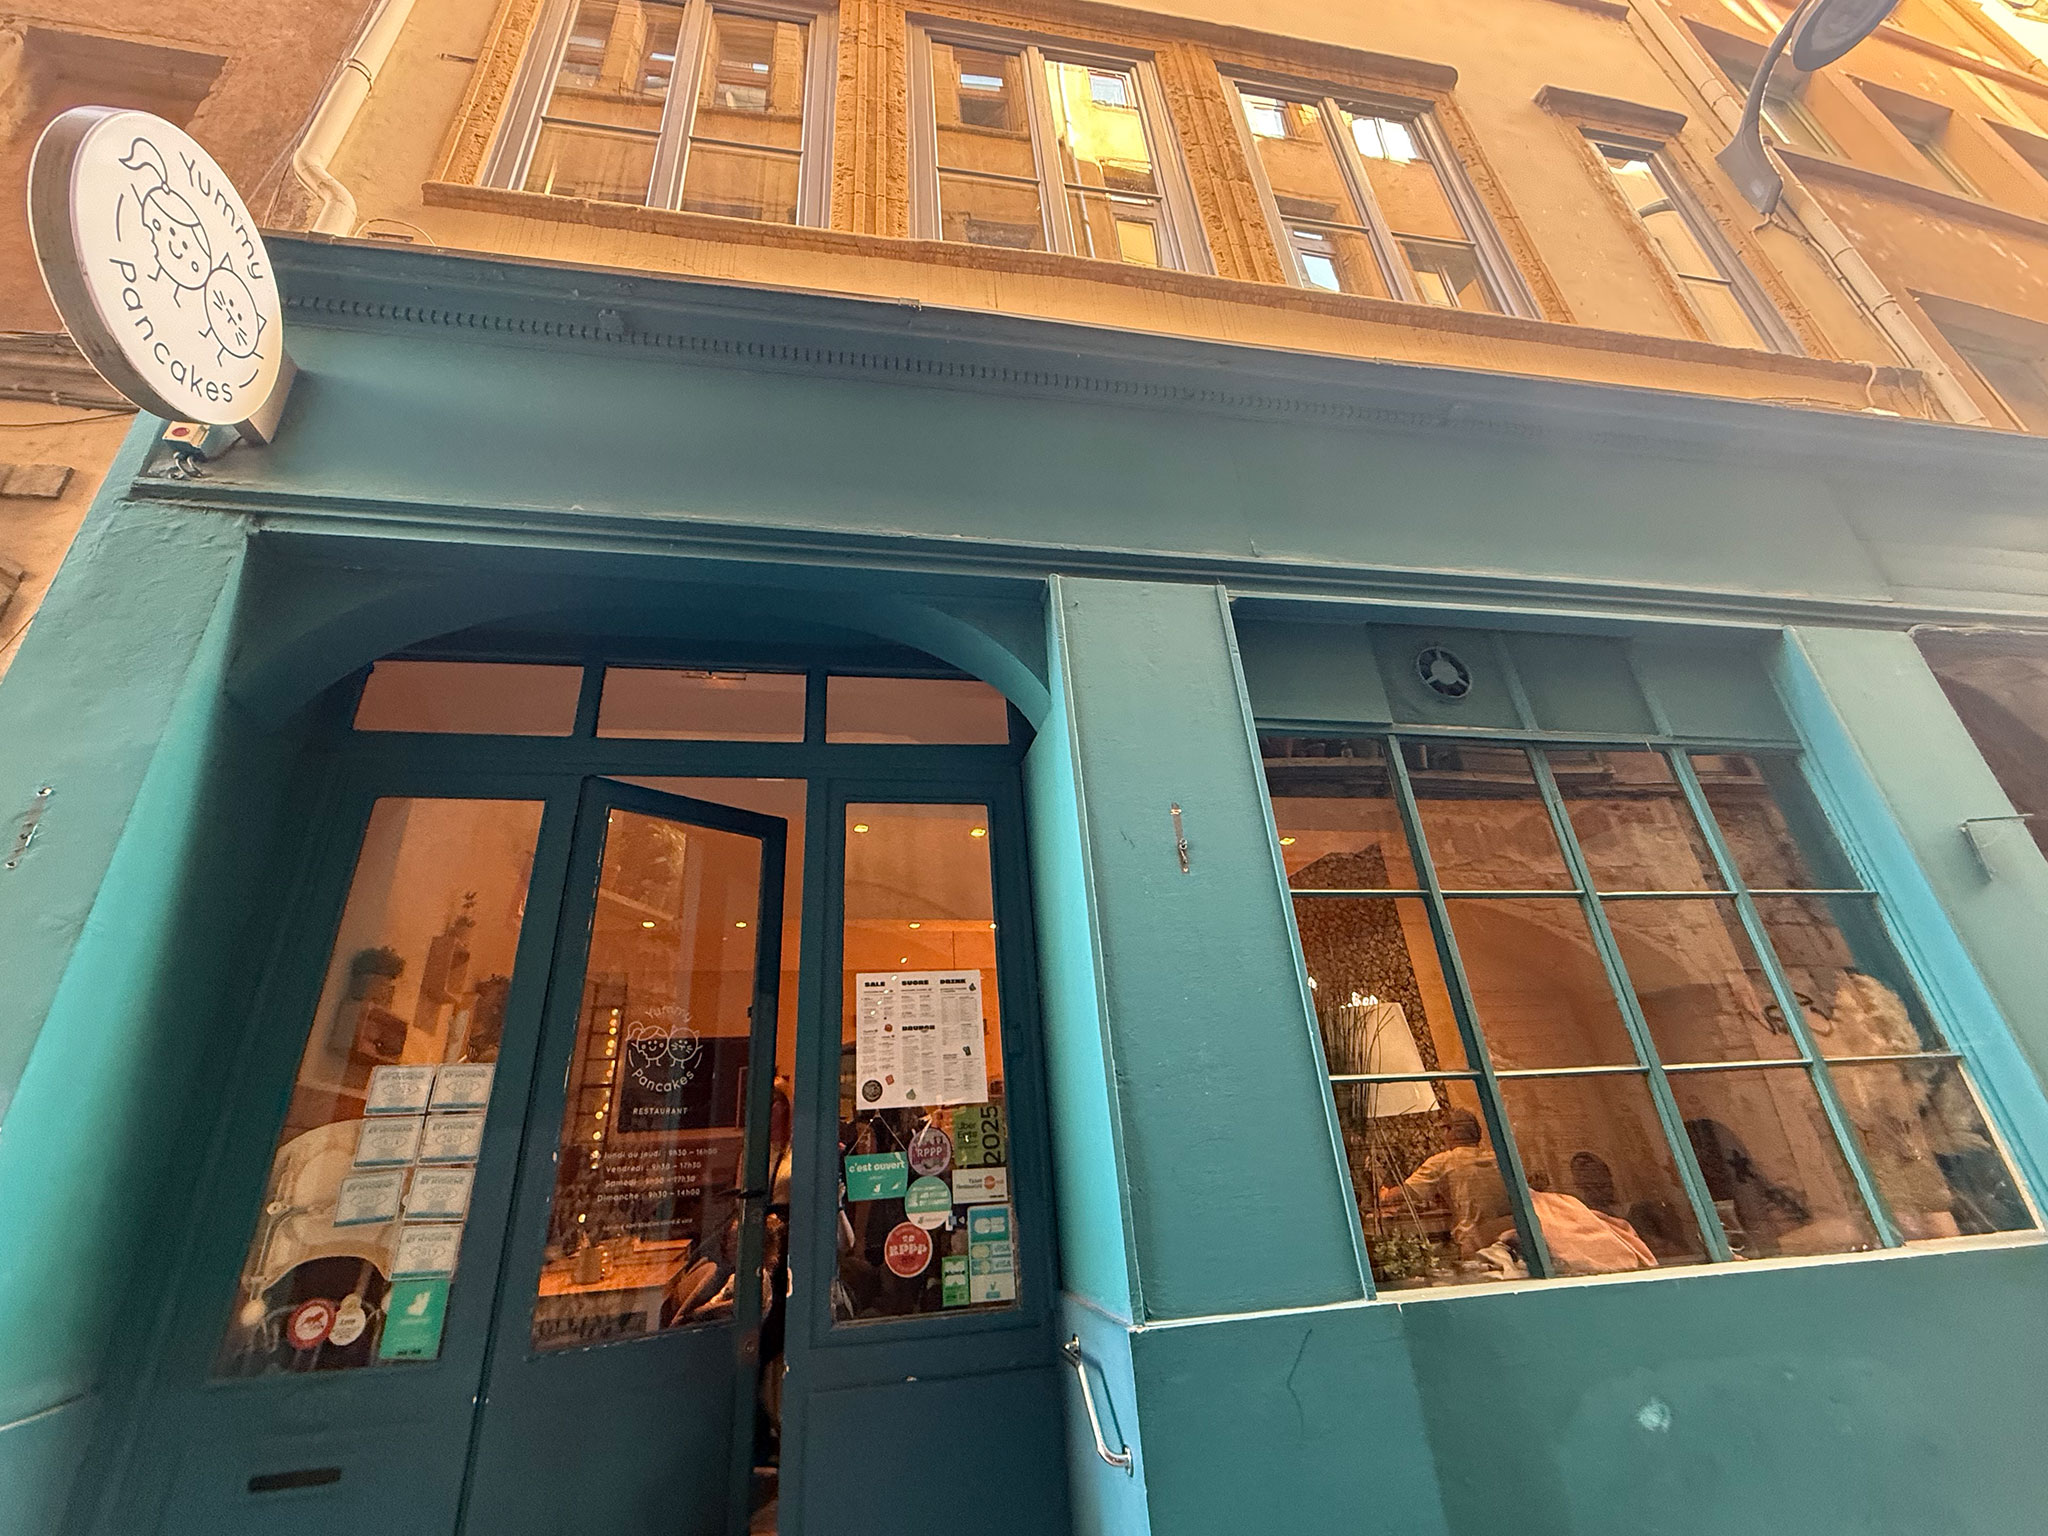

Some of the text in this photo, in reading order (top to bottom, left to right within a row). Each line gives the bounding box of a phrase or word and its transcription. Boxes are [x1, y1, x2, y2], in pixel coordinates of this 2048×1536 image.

[180, 151, 263, 280] Yummy
[109, 258, 233, 402] Pancakes
[644, 1005, 692, 1023] Yummy
[631, 1068, 695, 1092] Pancakes
[632, 1107, 688, 1115] RESTAURANT
[980, 1106, 1001, 1164] 2025
[604, 1151, 626, 1159] lundi
[606, 1165, 644, 1173] Vendredi
[849, 1161, 905, 1173] c'est ouvert
[597, 1193, 639, 1202] Dimanche
